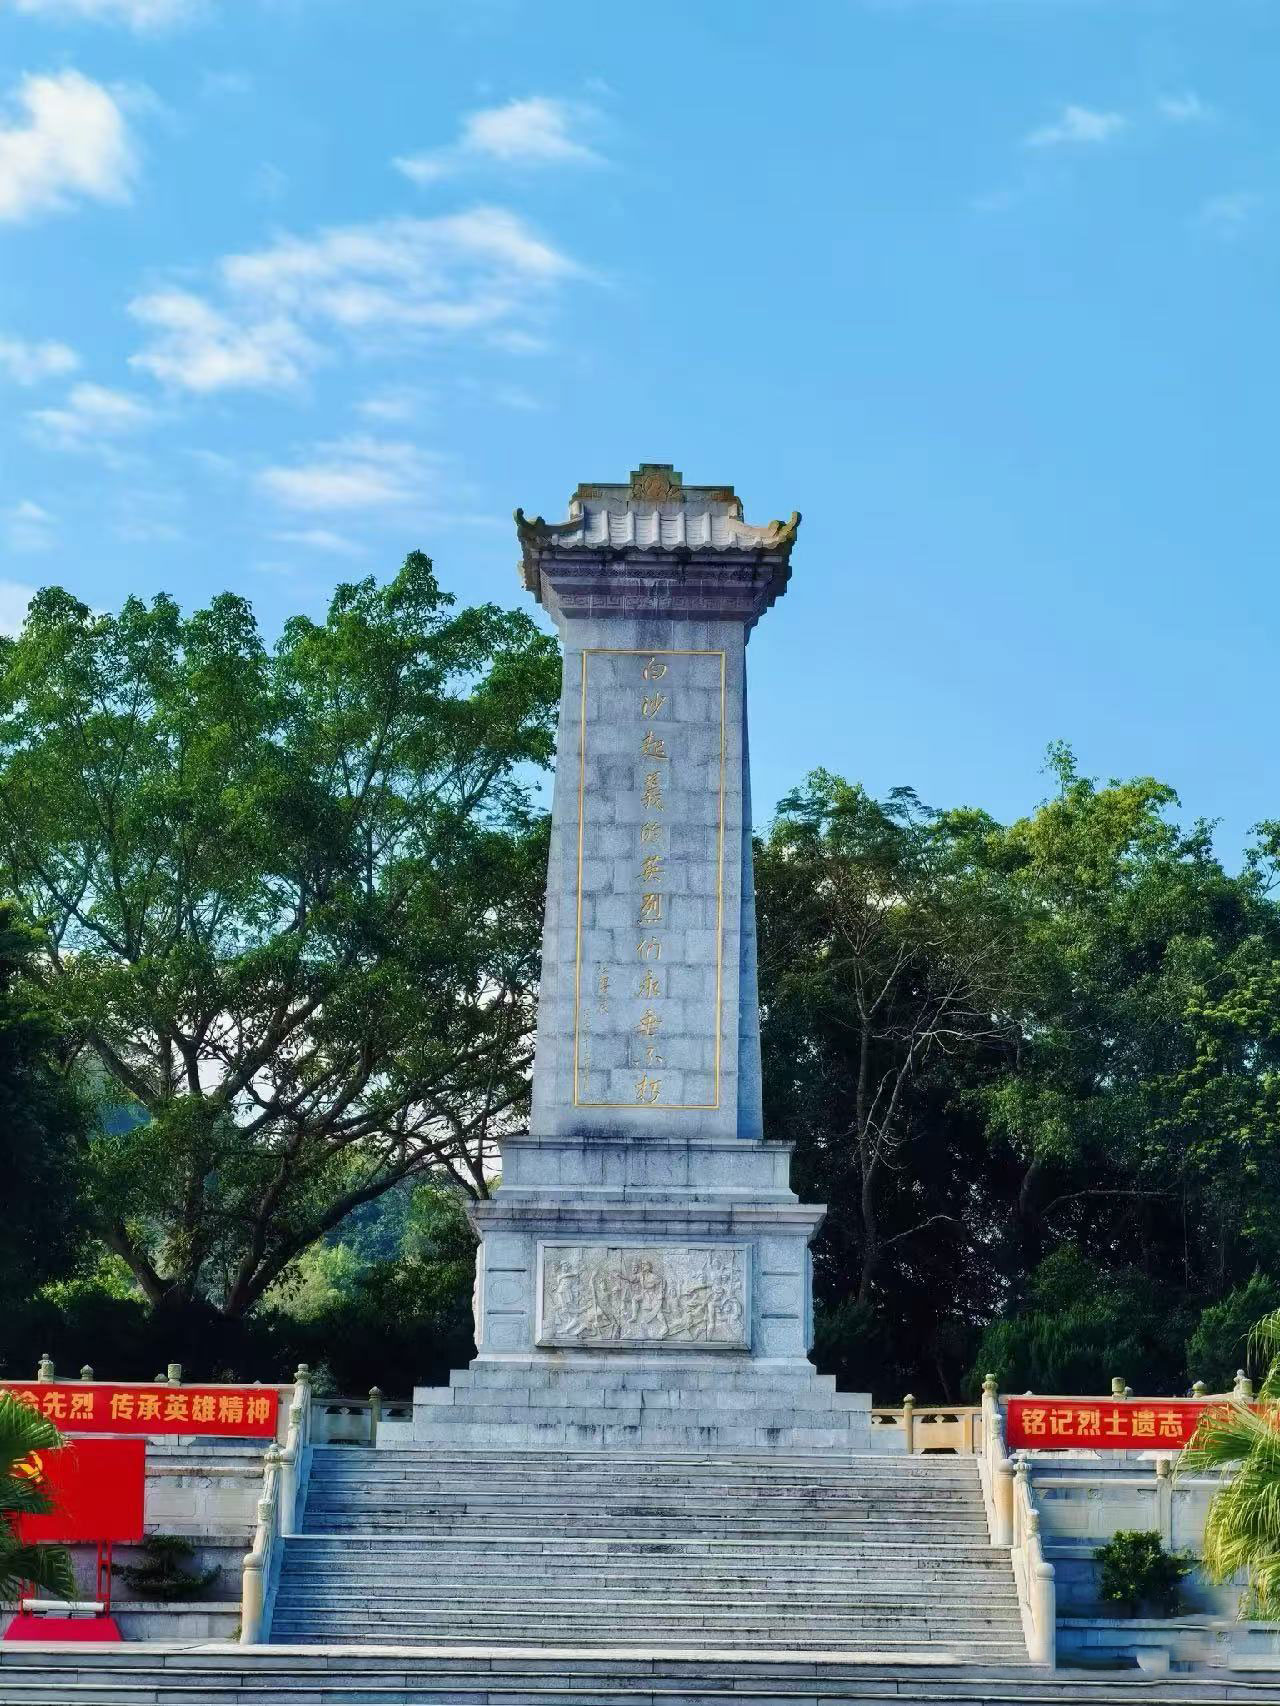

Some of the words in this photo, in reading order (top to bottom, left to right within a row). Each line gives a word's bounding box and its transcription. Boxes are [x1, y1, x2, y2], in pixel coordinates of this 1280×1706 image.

[110, 1393, 270, 1425] 传承英雄精神
[1021, 1408, 1183, 1438] 铭记烈士遗志
